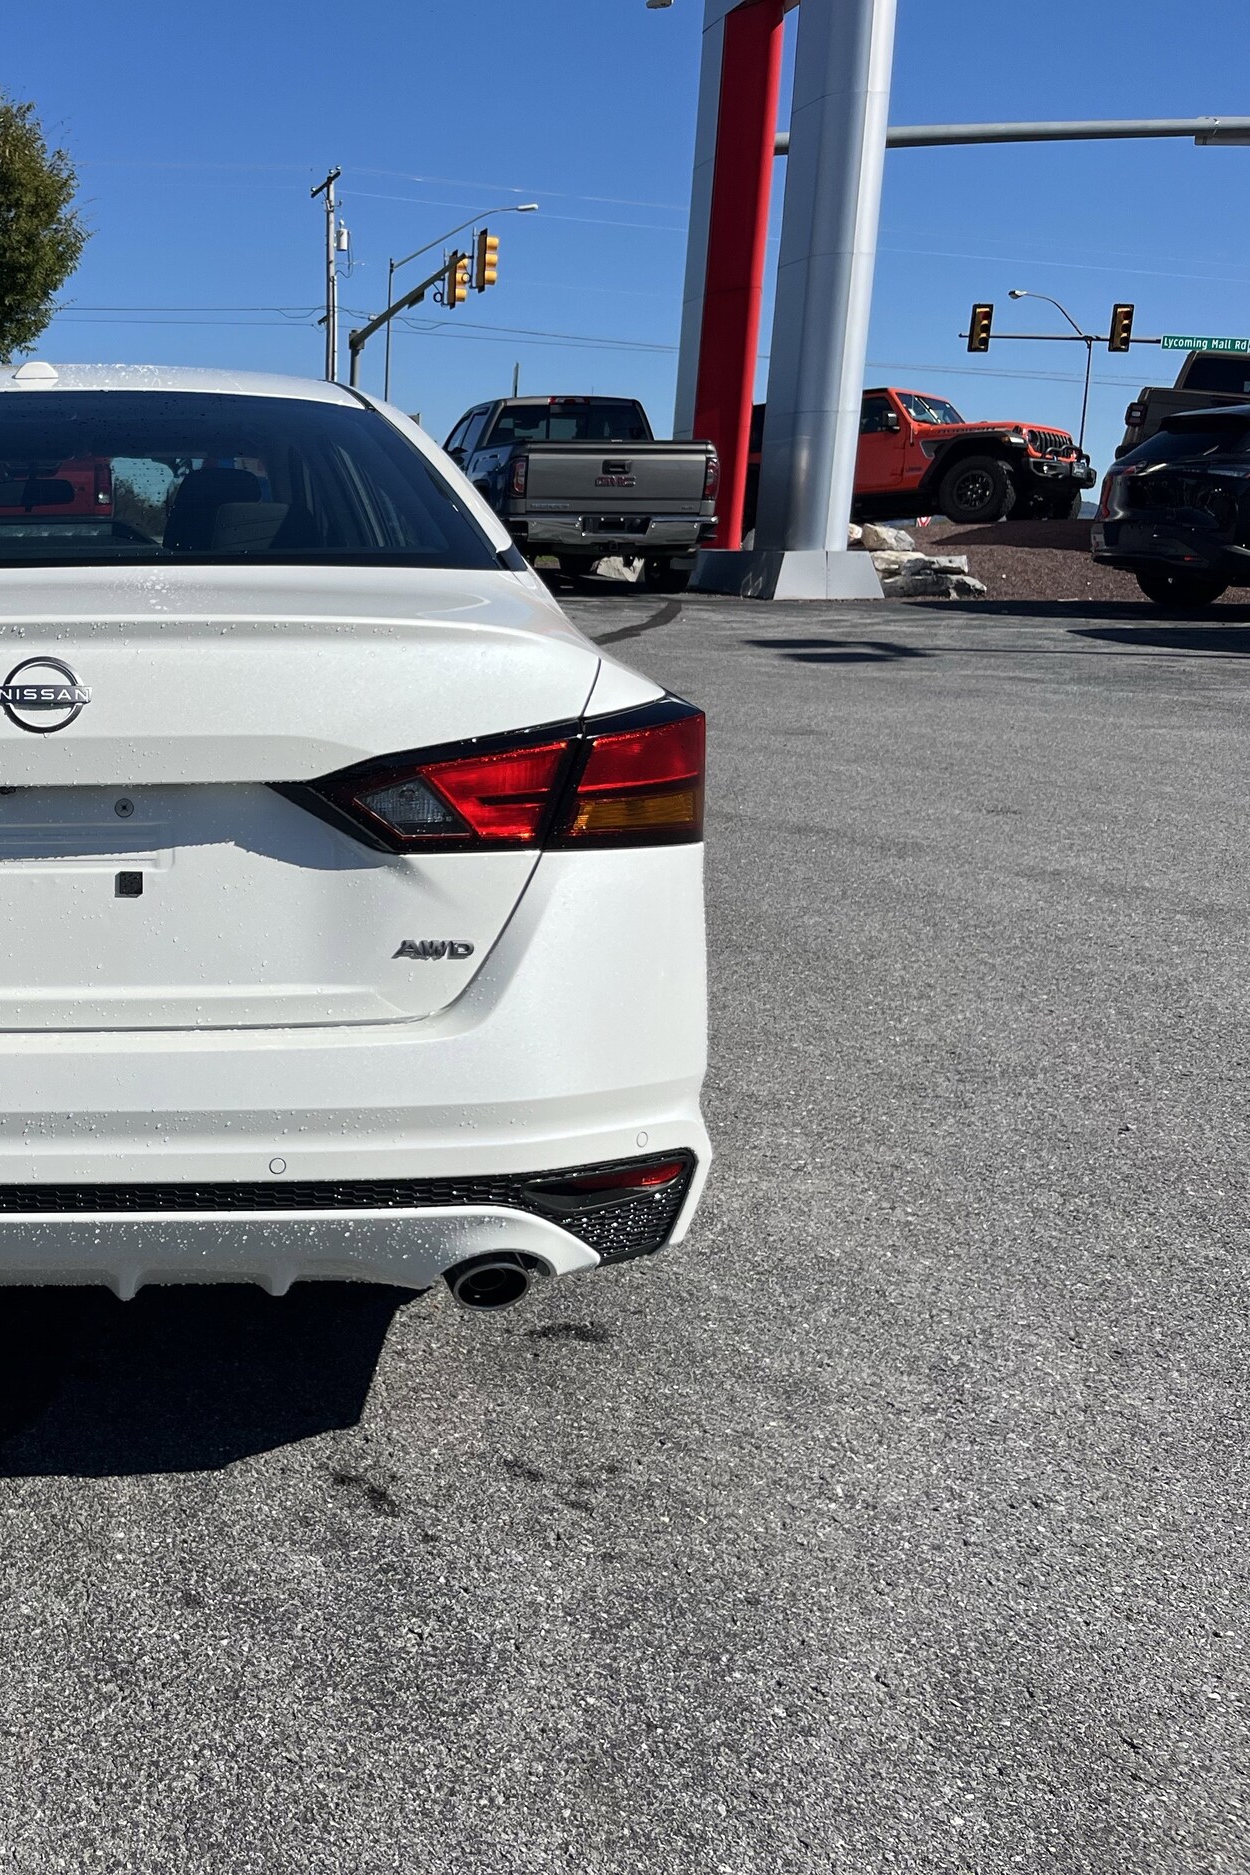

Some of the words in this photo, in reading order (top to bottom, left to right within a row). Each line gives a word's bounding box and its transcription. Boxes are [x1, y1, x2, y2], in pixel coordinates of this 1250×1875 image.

[1163, 337, 1208, 351] Lycoming
[1211, 339, 1231, 349] Mall
[1234, 341, 1247, 351] Rd
[595, 476, 636, 487] GMC
[393, 939, 475, 958] AWD
